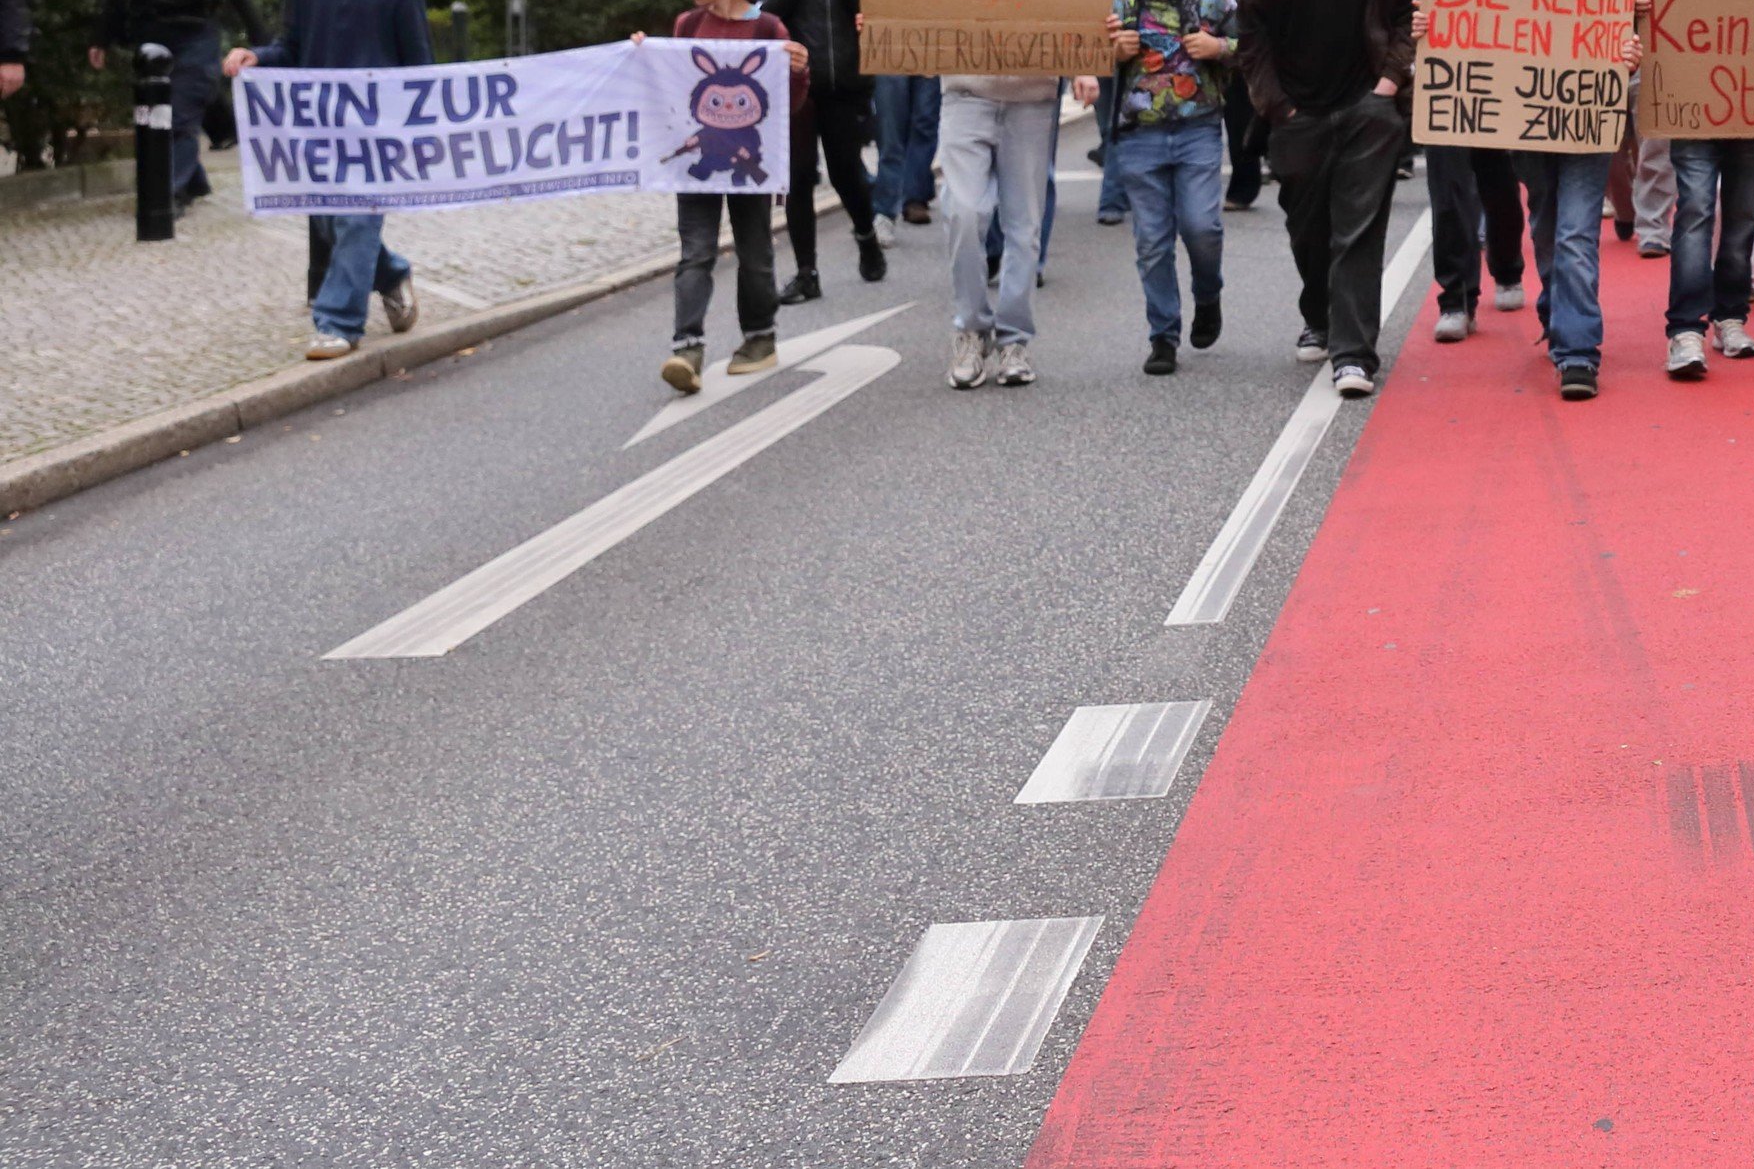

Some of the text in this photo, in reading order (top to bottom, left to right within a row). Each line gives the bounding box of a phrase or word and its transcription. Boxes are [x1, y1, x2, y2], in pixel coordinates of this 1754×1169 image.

[863, 25, 1115, 72] MUSTERUNGSZENTRUM
[1427, 9, 1632, 63] WOLLEN KRIEG
[243, 73, 518, 128] NEIN ZUR
[1422, 57, 1623, 107] DIE JUGEND
[1651, 60, 1701, 130] fürs
[249, 110, 640, 183] WEHRPFLICHT!
[1428, 95, 1628, 146] EINE ZUKUNFT
